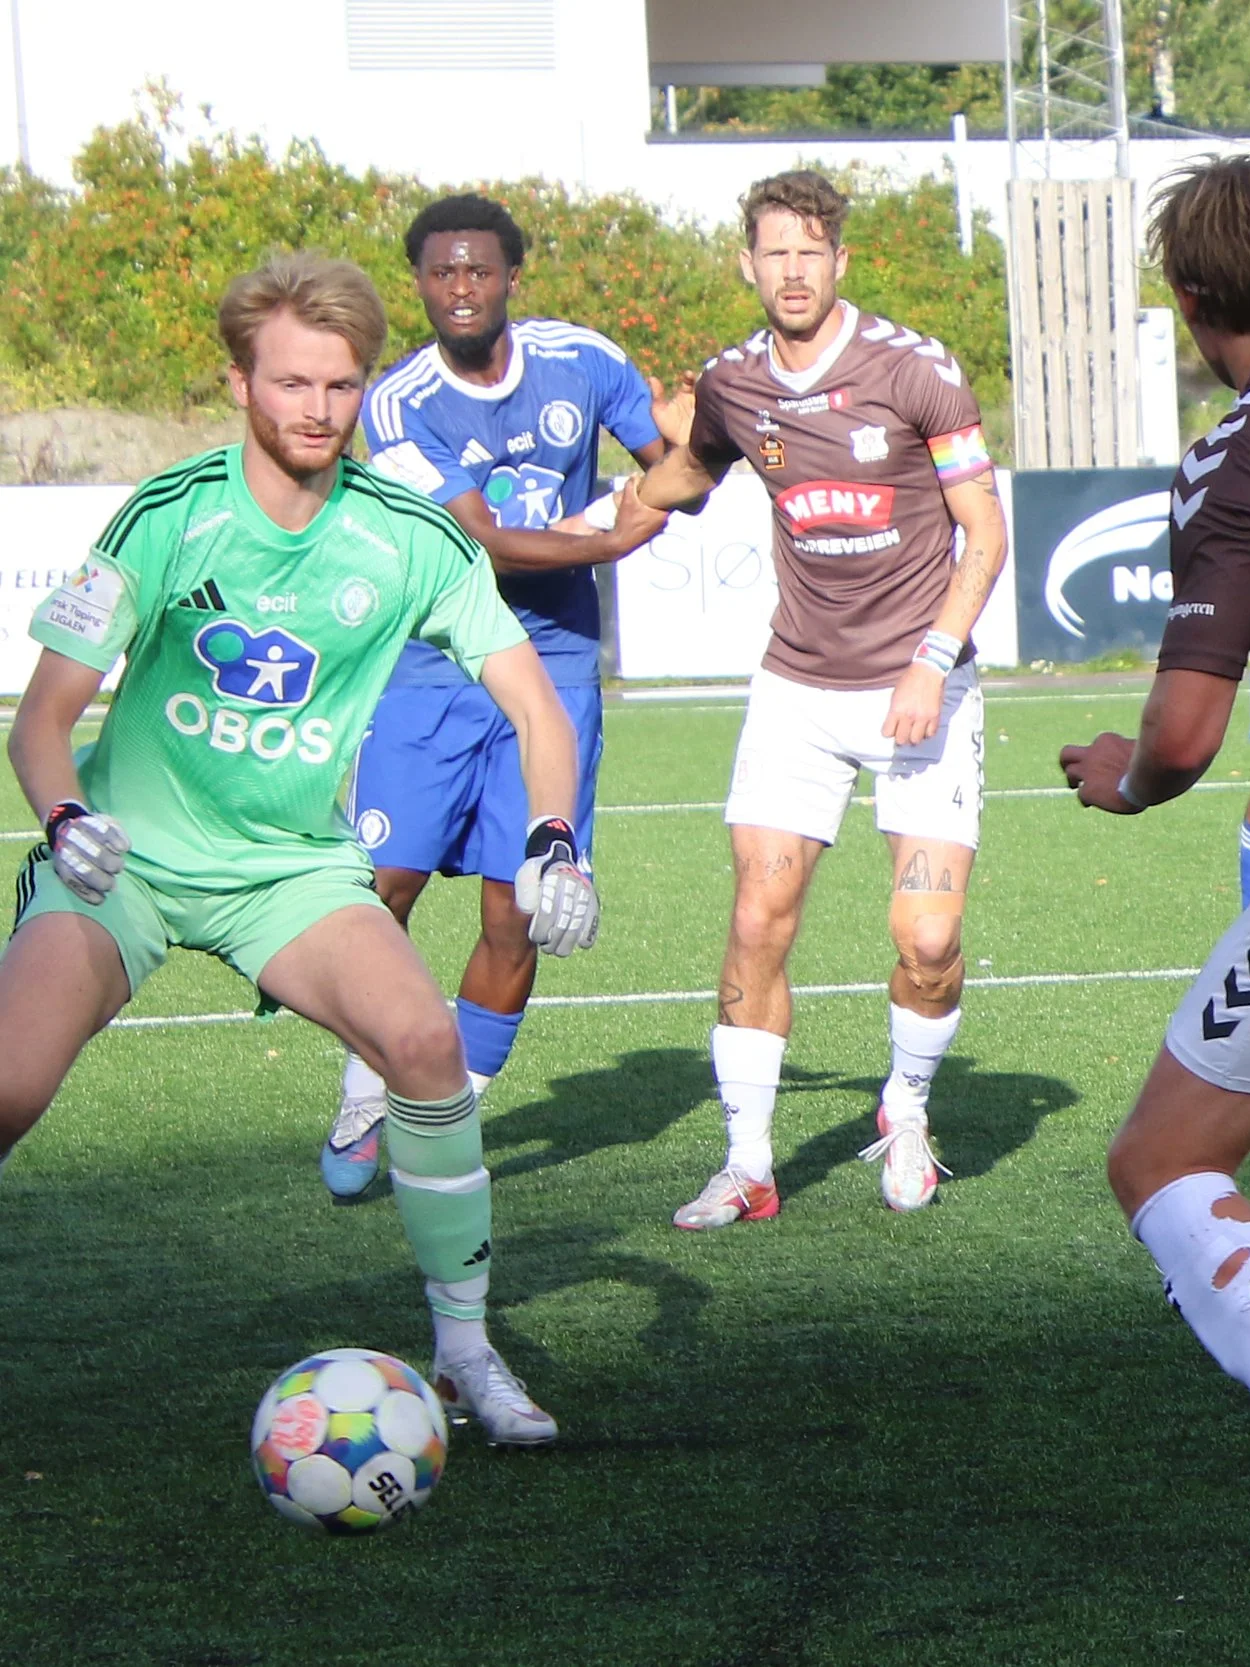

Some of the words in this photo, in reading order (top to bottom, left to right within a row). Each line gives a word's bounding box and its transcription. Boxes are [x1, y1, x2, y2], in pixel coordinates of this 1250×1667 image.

[507, 430, 538, 456] ecit
[784, 489, 881, 523] MENY
[255, 591, 298, 613] ecit
[165, 692, 334, 765] OBOS
[951, 784, 964, 810] 4
